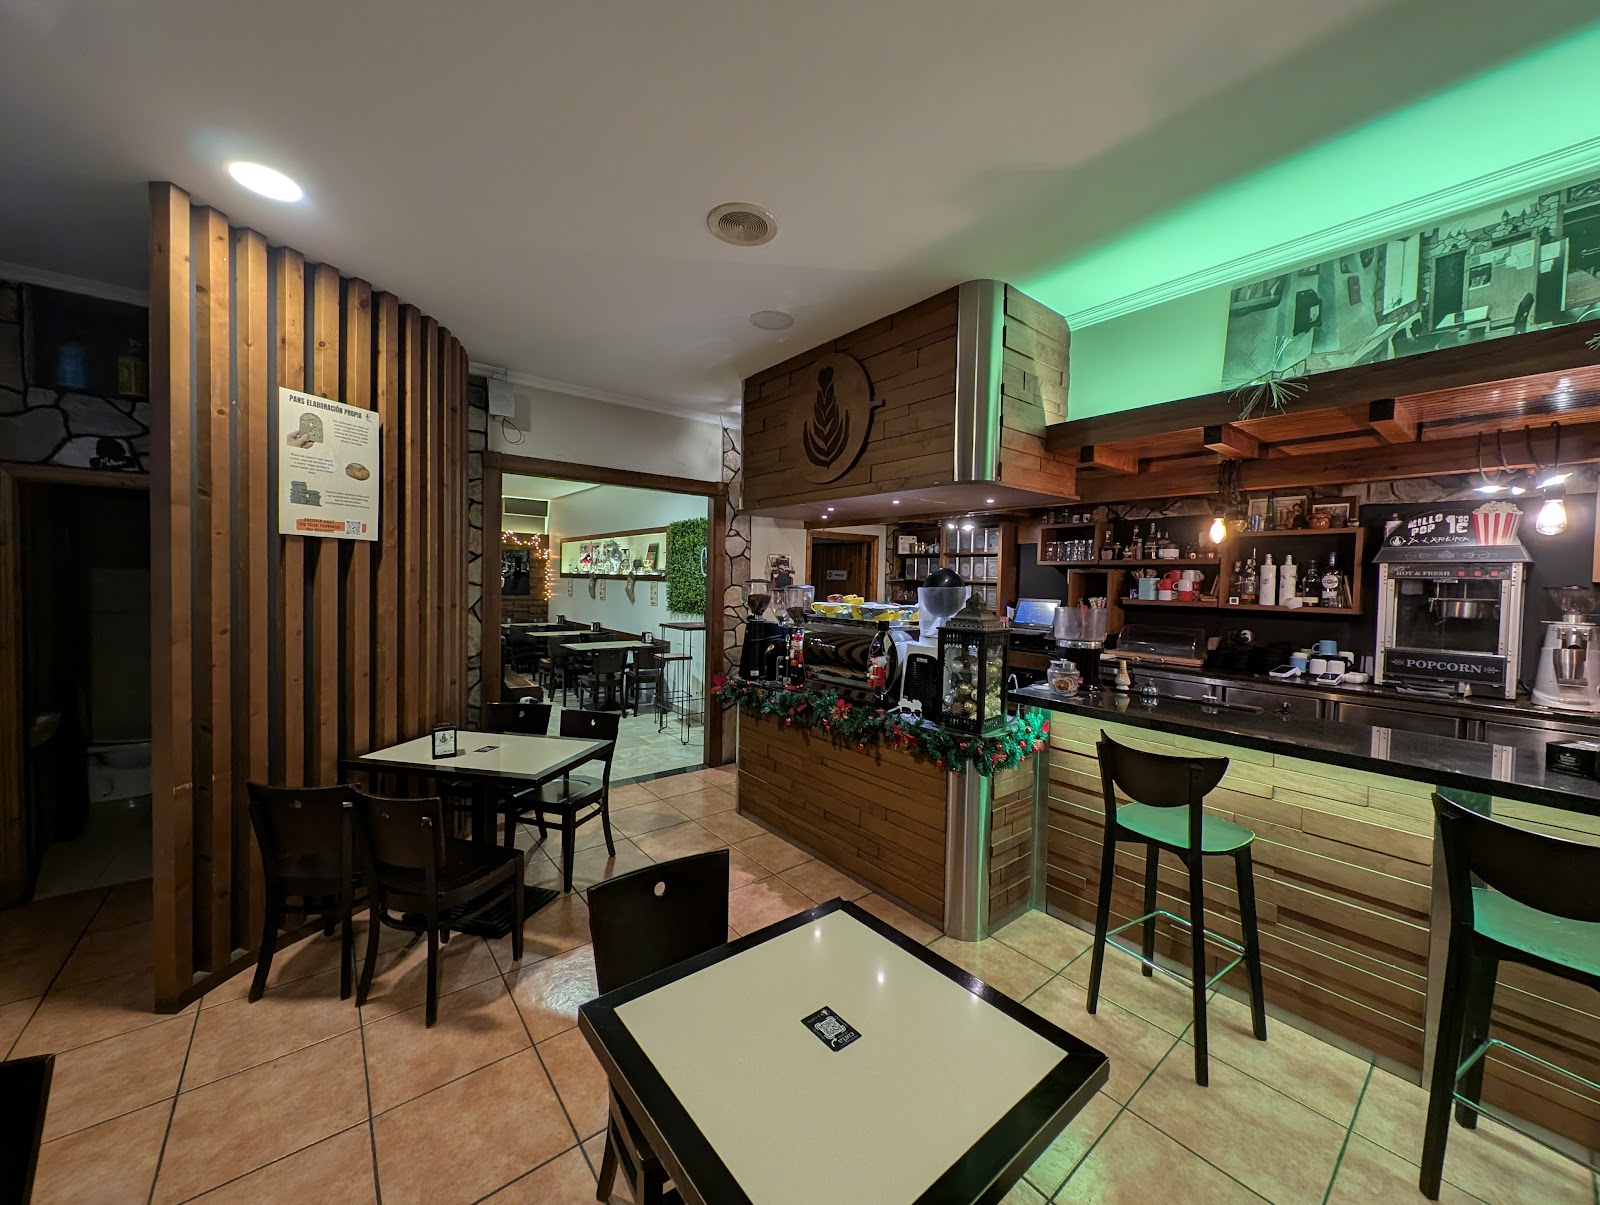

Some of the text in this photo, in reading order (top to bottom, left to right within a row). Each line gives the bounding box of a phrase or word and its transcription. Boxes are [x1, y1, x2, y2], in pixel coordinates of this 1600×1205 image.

[289, 394, 362, 419] PANS ELABORACIÓN PROPIA
[1411, 523, 1436, 536] POP
[1406, 659, 1483, 674] POPCORN
